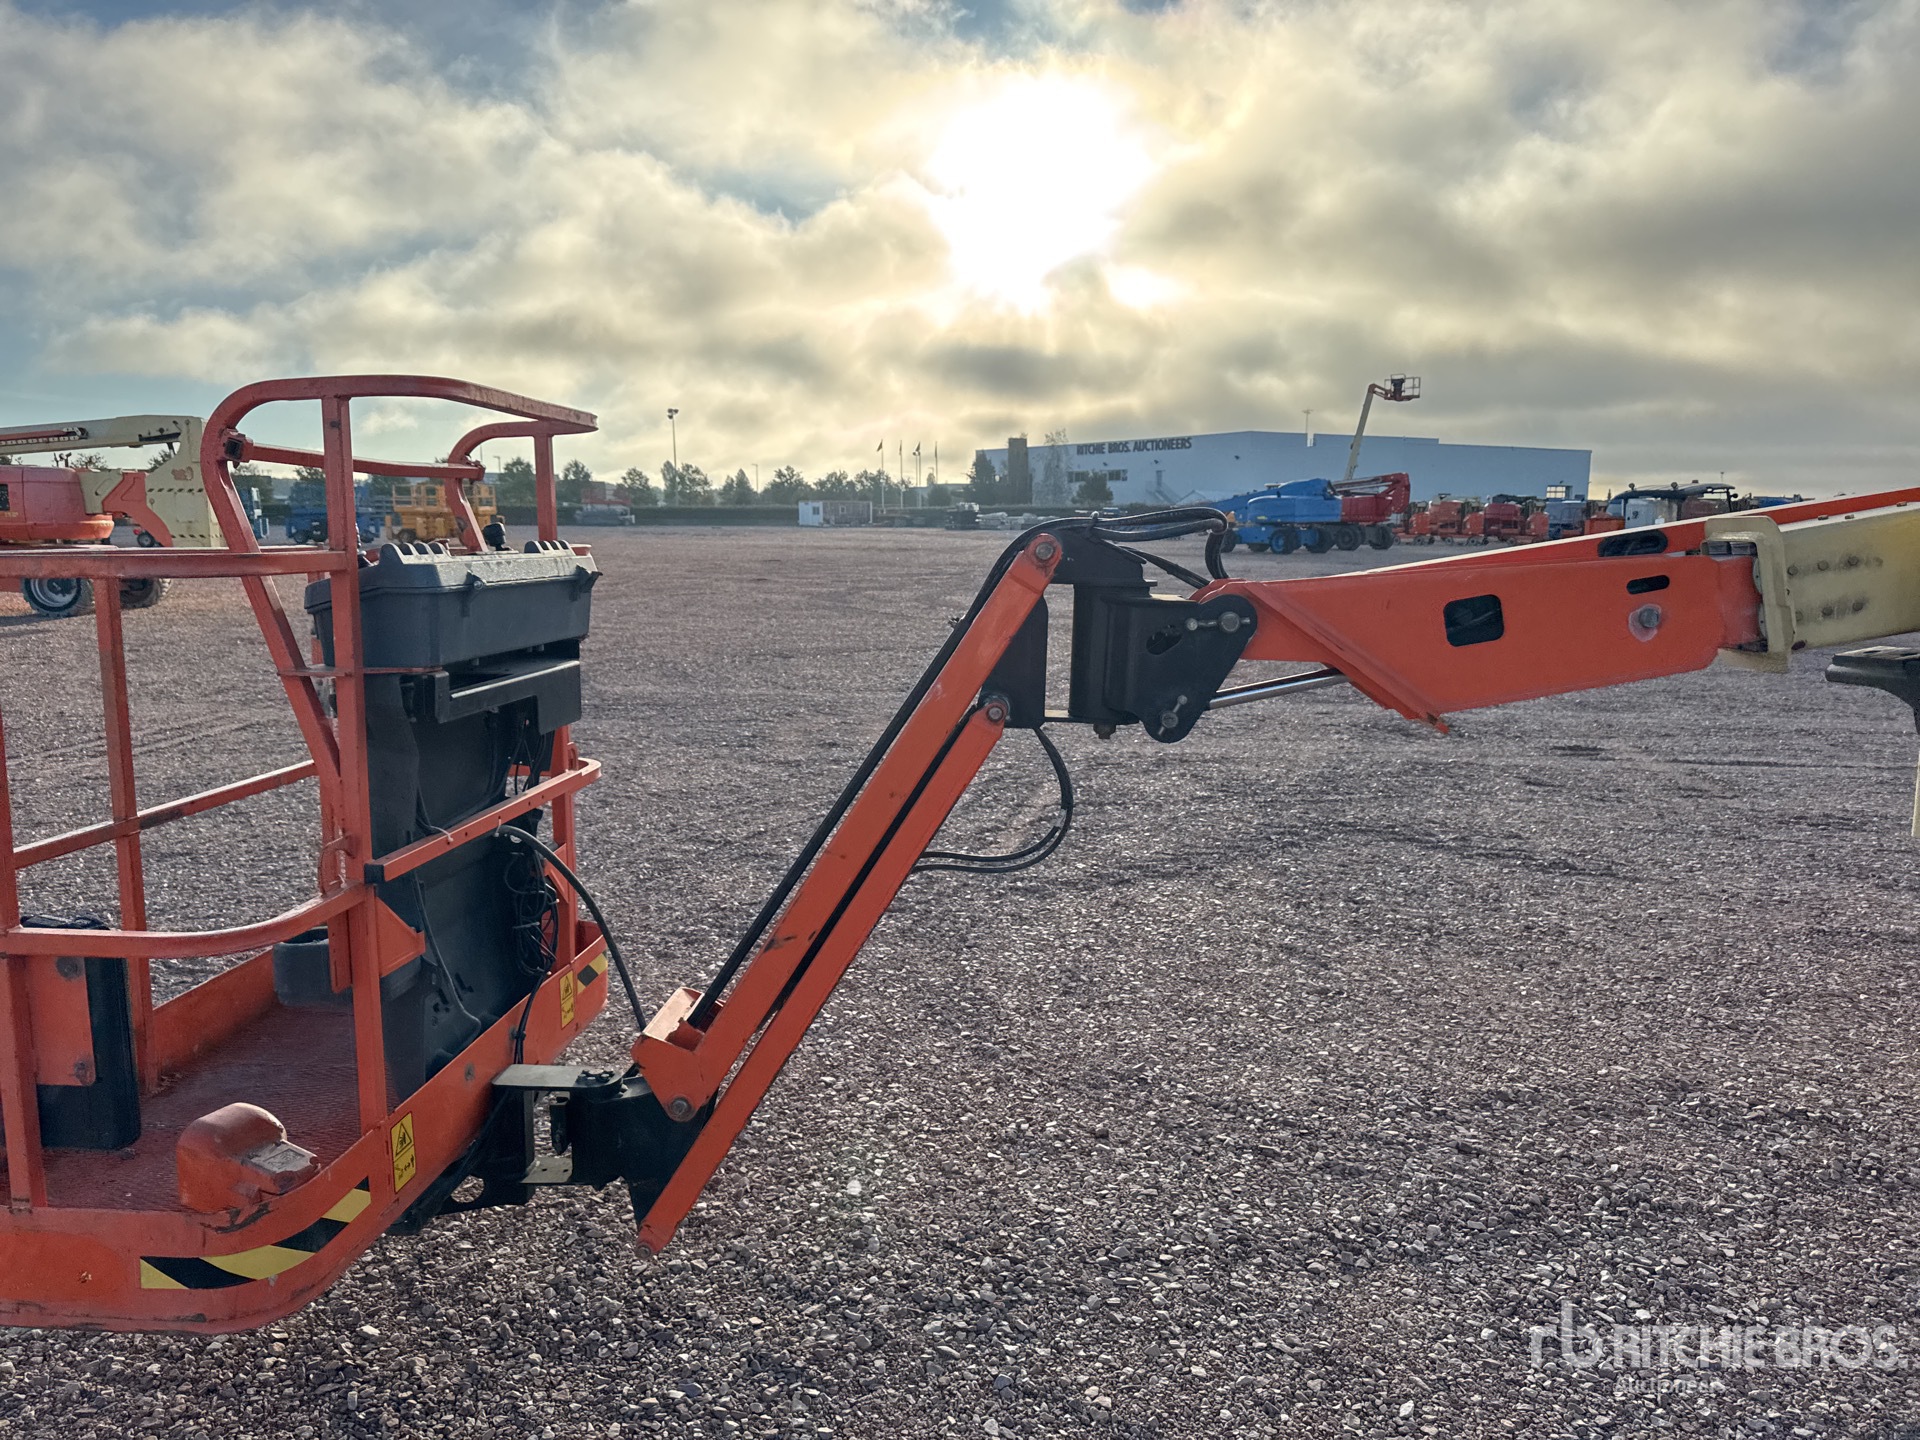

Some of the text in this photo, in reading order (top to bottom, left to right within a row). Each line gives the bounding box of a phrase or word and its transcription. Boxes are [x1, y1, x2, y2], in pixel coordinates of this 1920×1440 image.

[1077, 437, 1193, 455] RITCHIE BROS. AUCTIONEERS
